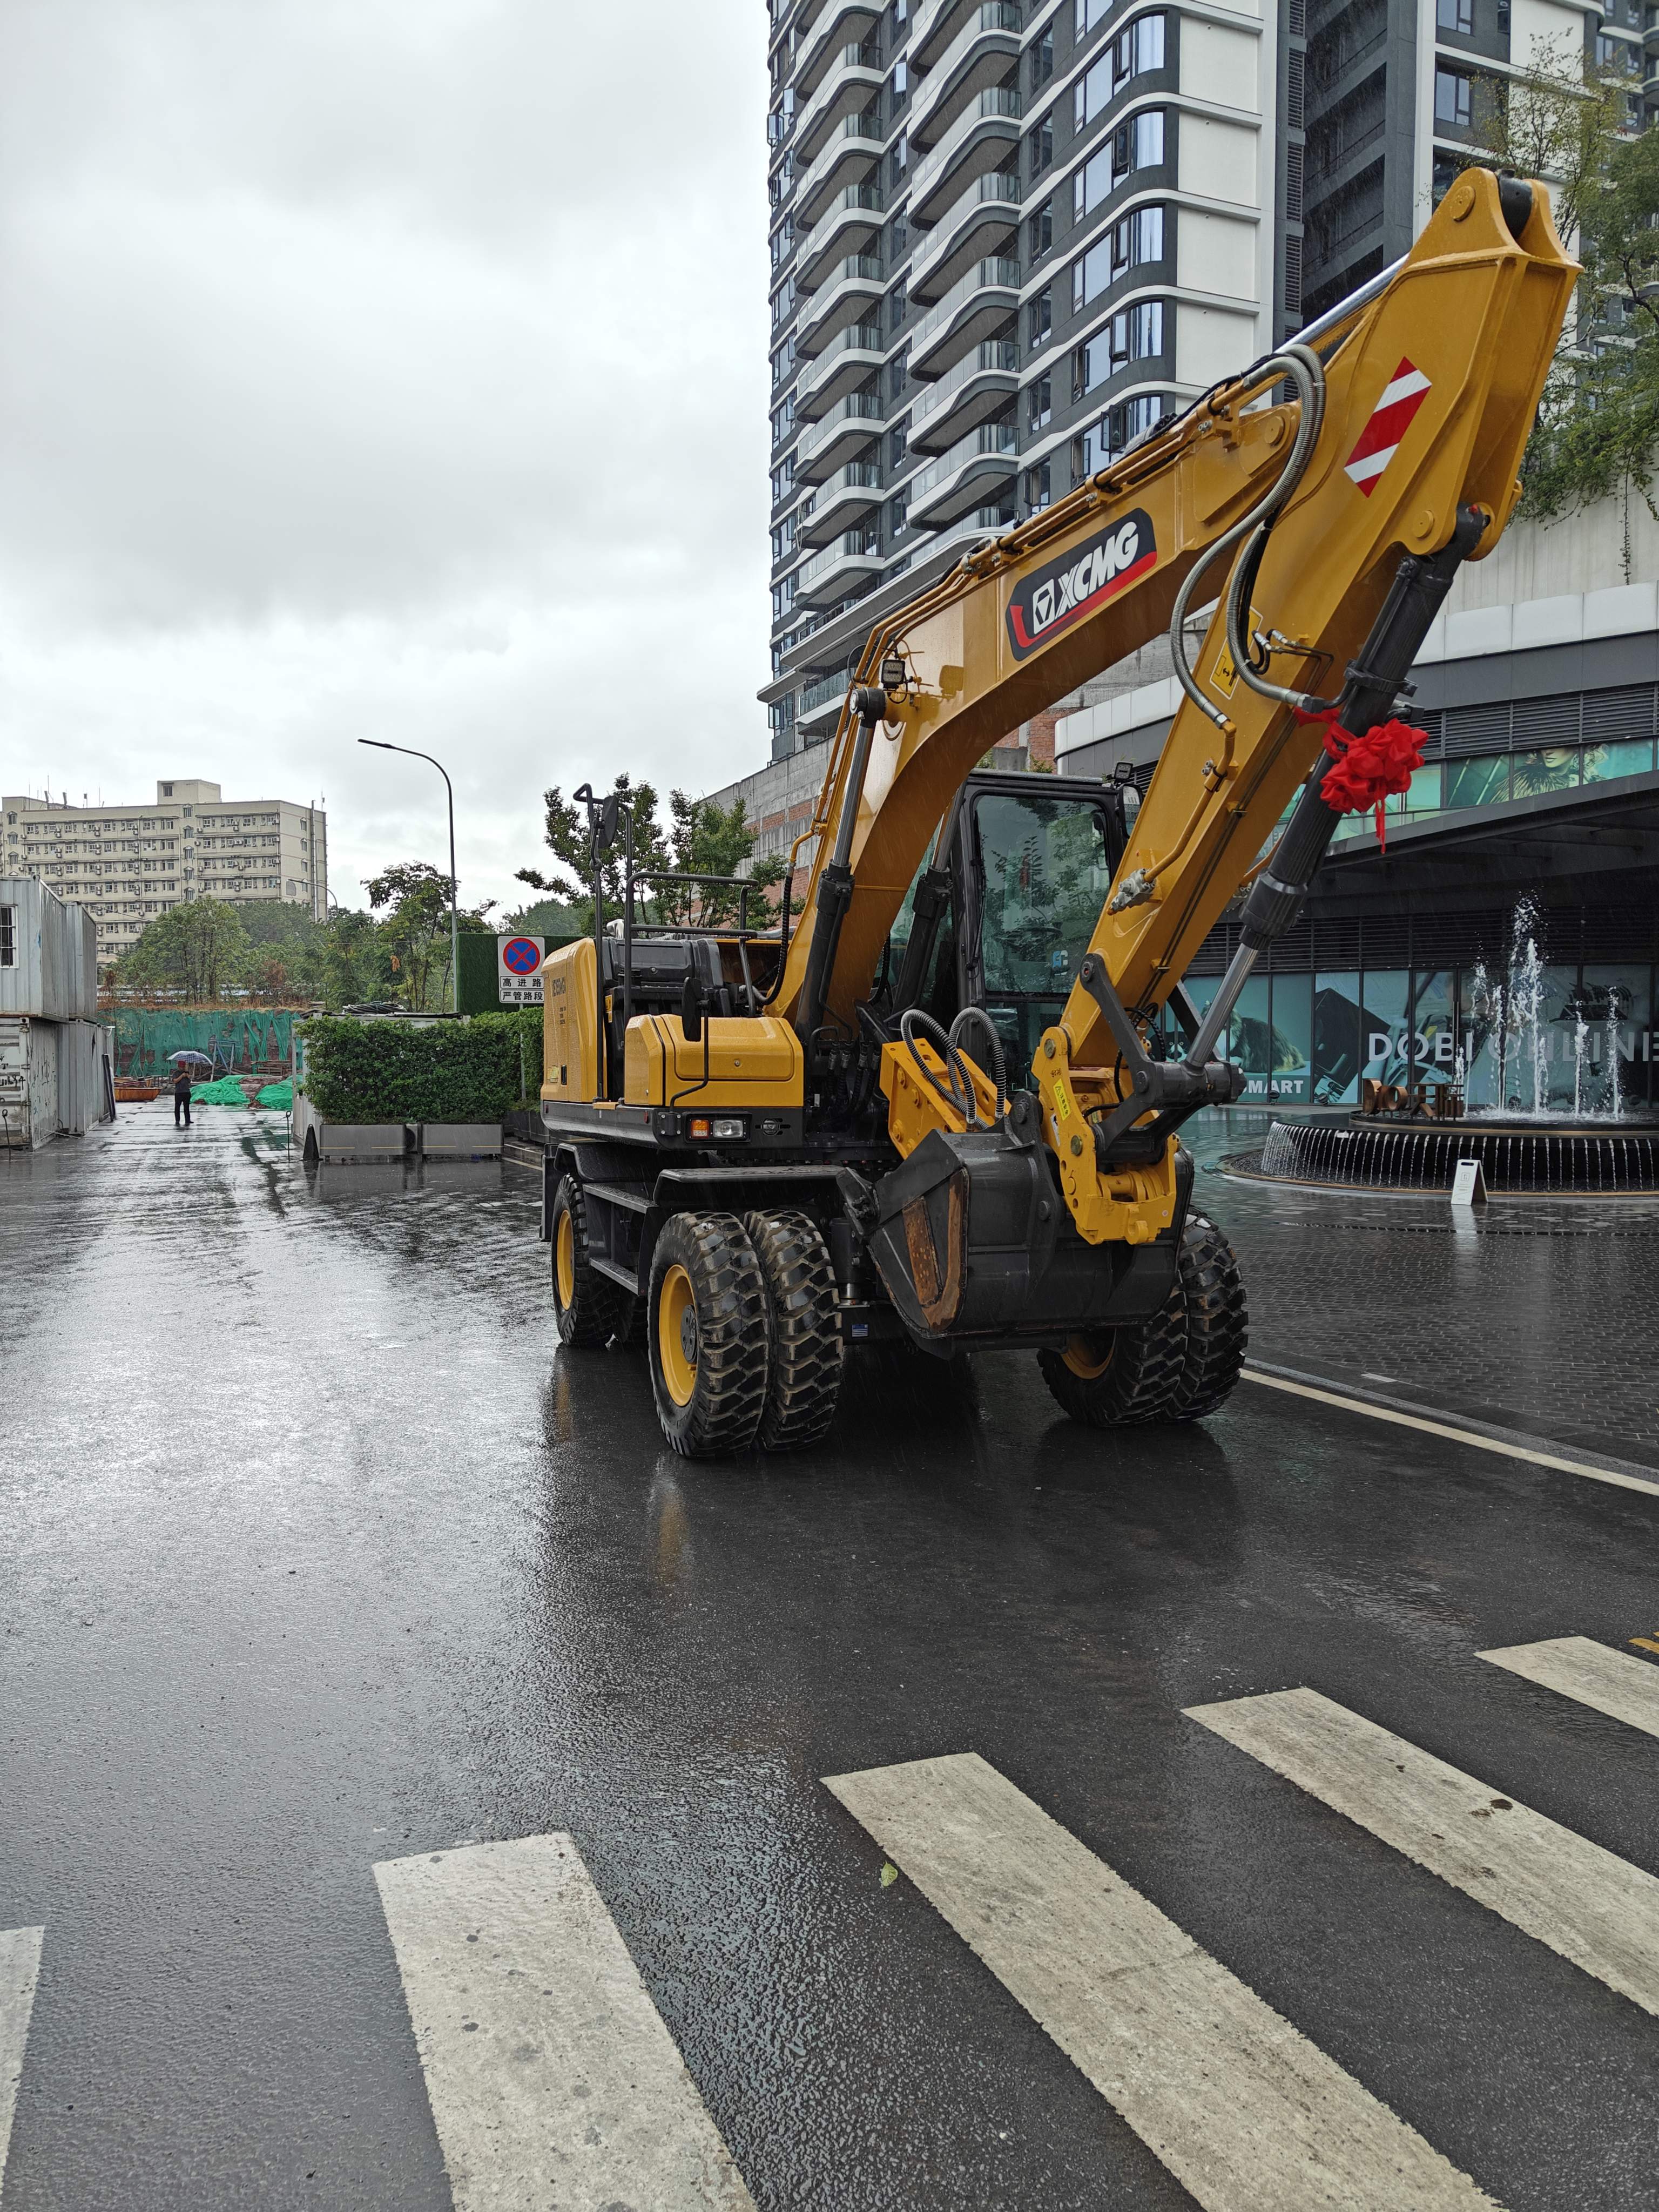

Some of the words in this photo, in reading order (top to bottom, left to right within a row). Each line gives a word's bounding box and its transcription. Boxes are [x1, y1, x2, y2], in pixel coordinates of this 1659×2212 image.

[1054, 521, 1139, 620] XCMG
[502, 978, 542, 988] 高进路
[502, 991, 543, 1001] 严管路段
[1368, 1032, 1473, 1061] DOBI
[1242, 1080, 1304, 1094] MART
